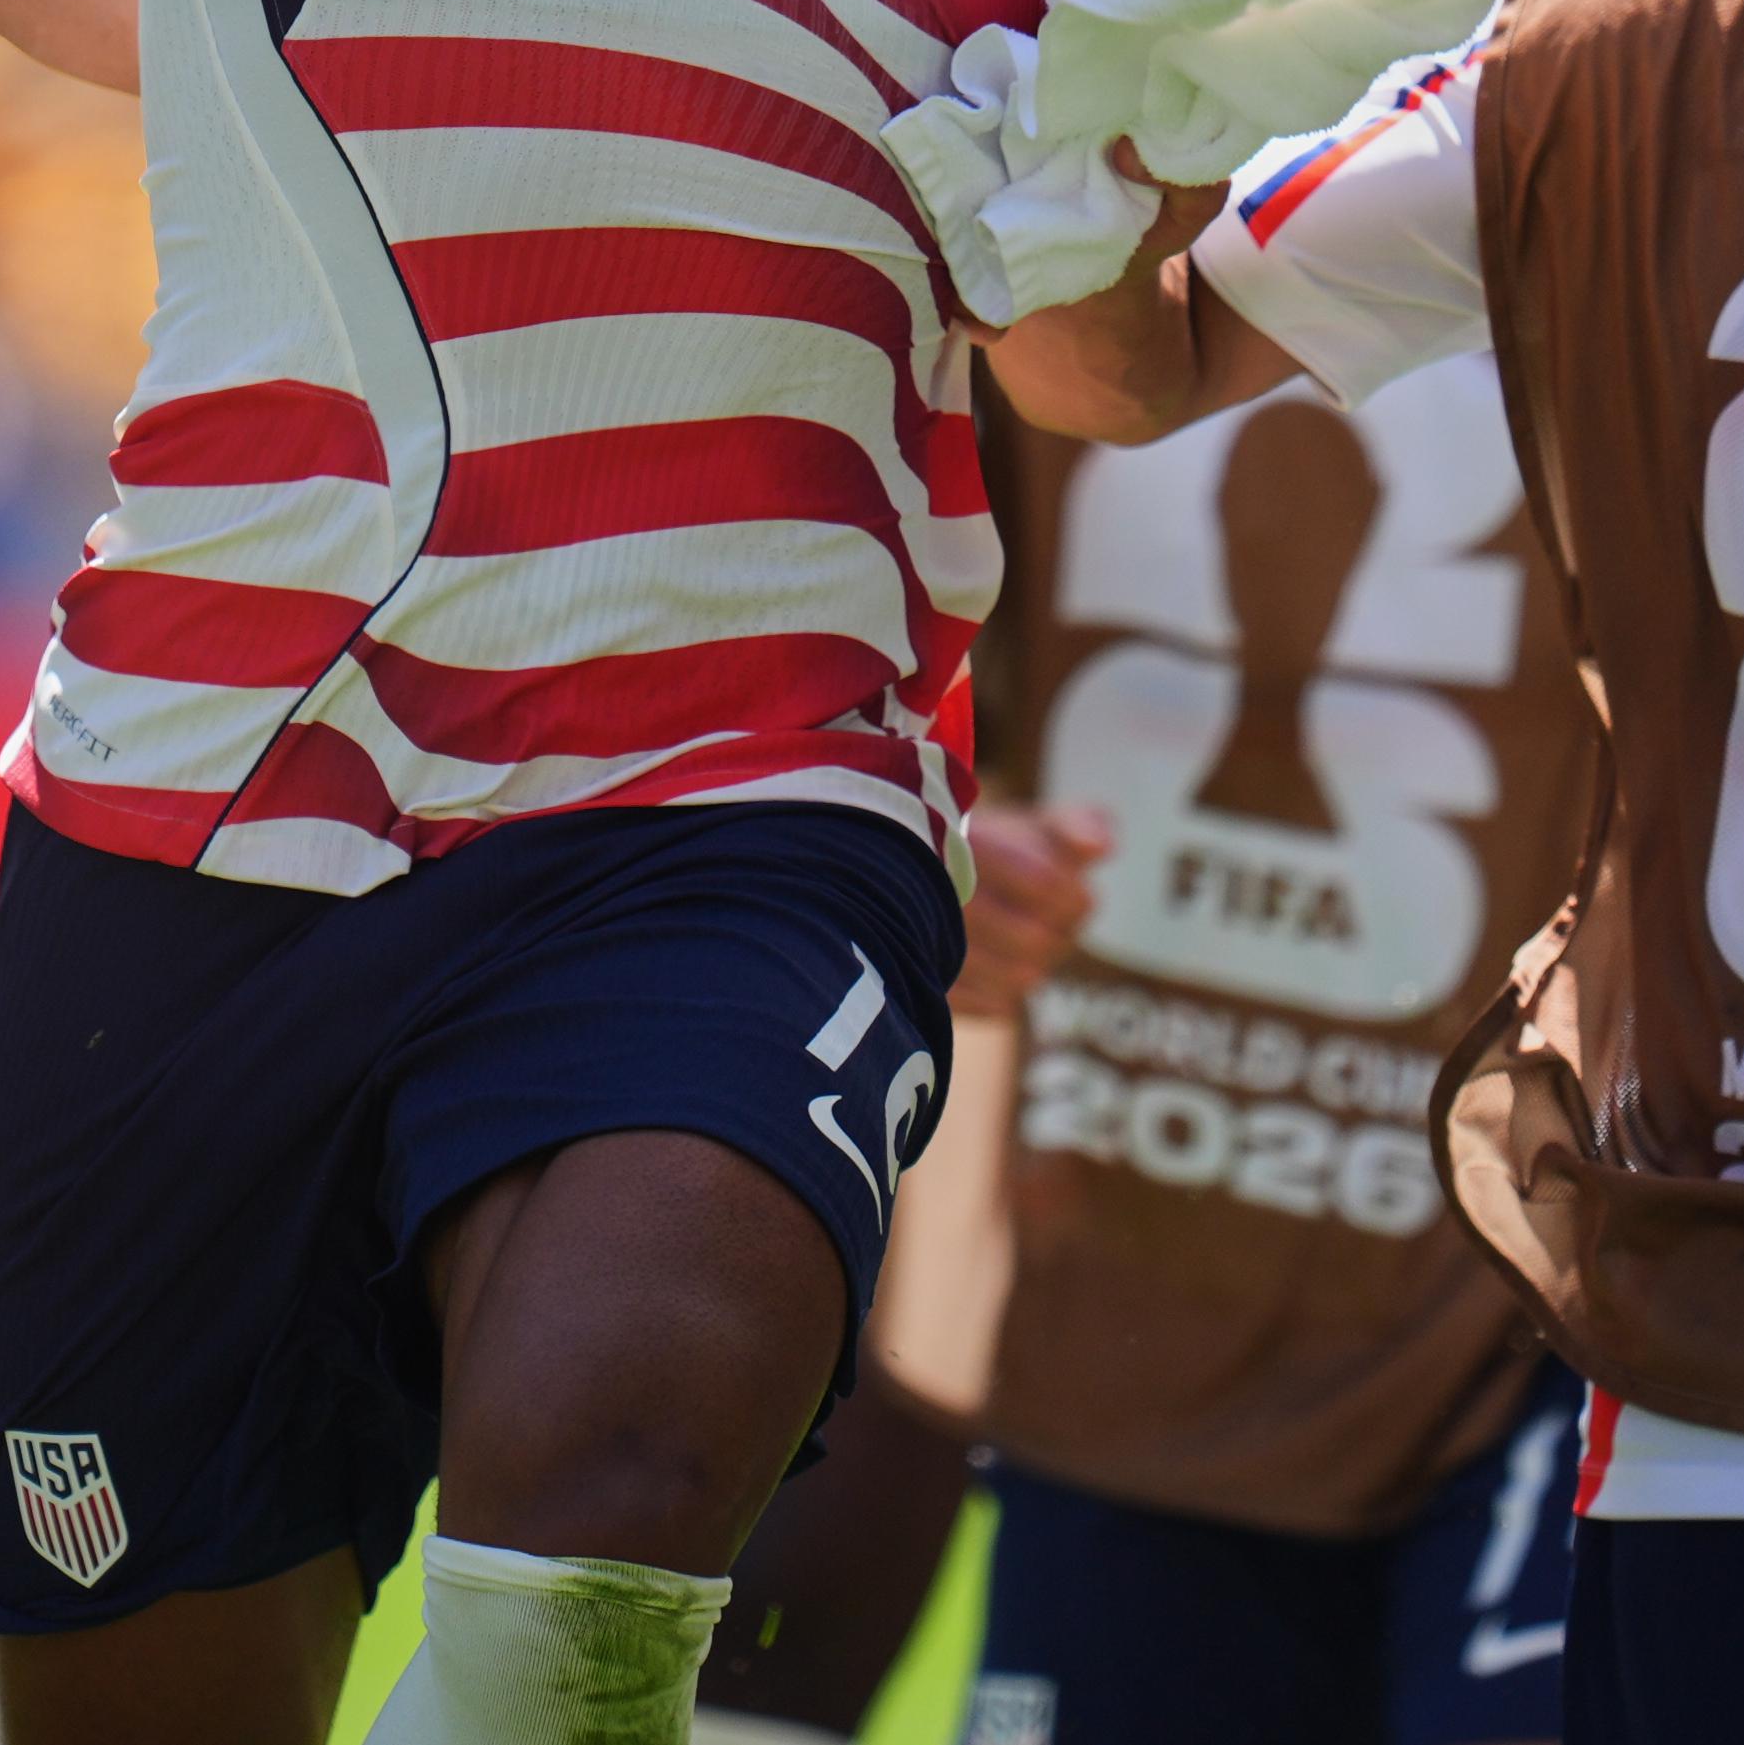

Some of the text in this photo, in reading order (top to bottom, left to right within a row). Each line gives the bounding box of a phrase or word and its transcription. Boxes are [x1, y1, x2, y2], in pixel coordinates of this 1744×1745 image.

[1163, 846, 1361, 942] FIFA
[1023, 982, 1305, 1094] WORLD
[1020, 1054, 1443, 1238] 2026
[11, 1438, 102, 1500] USA
